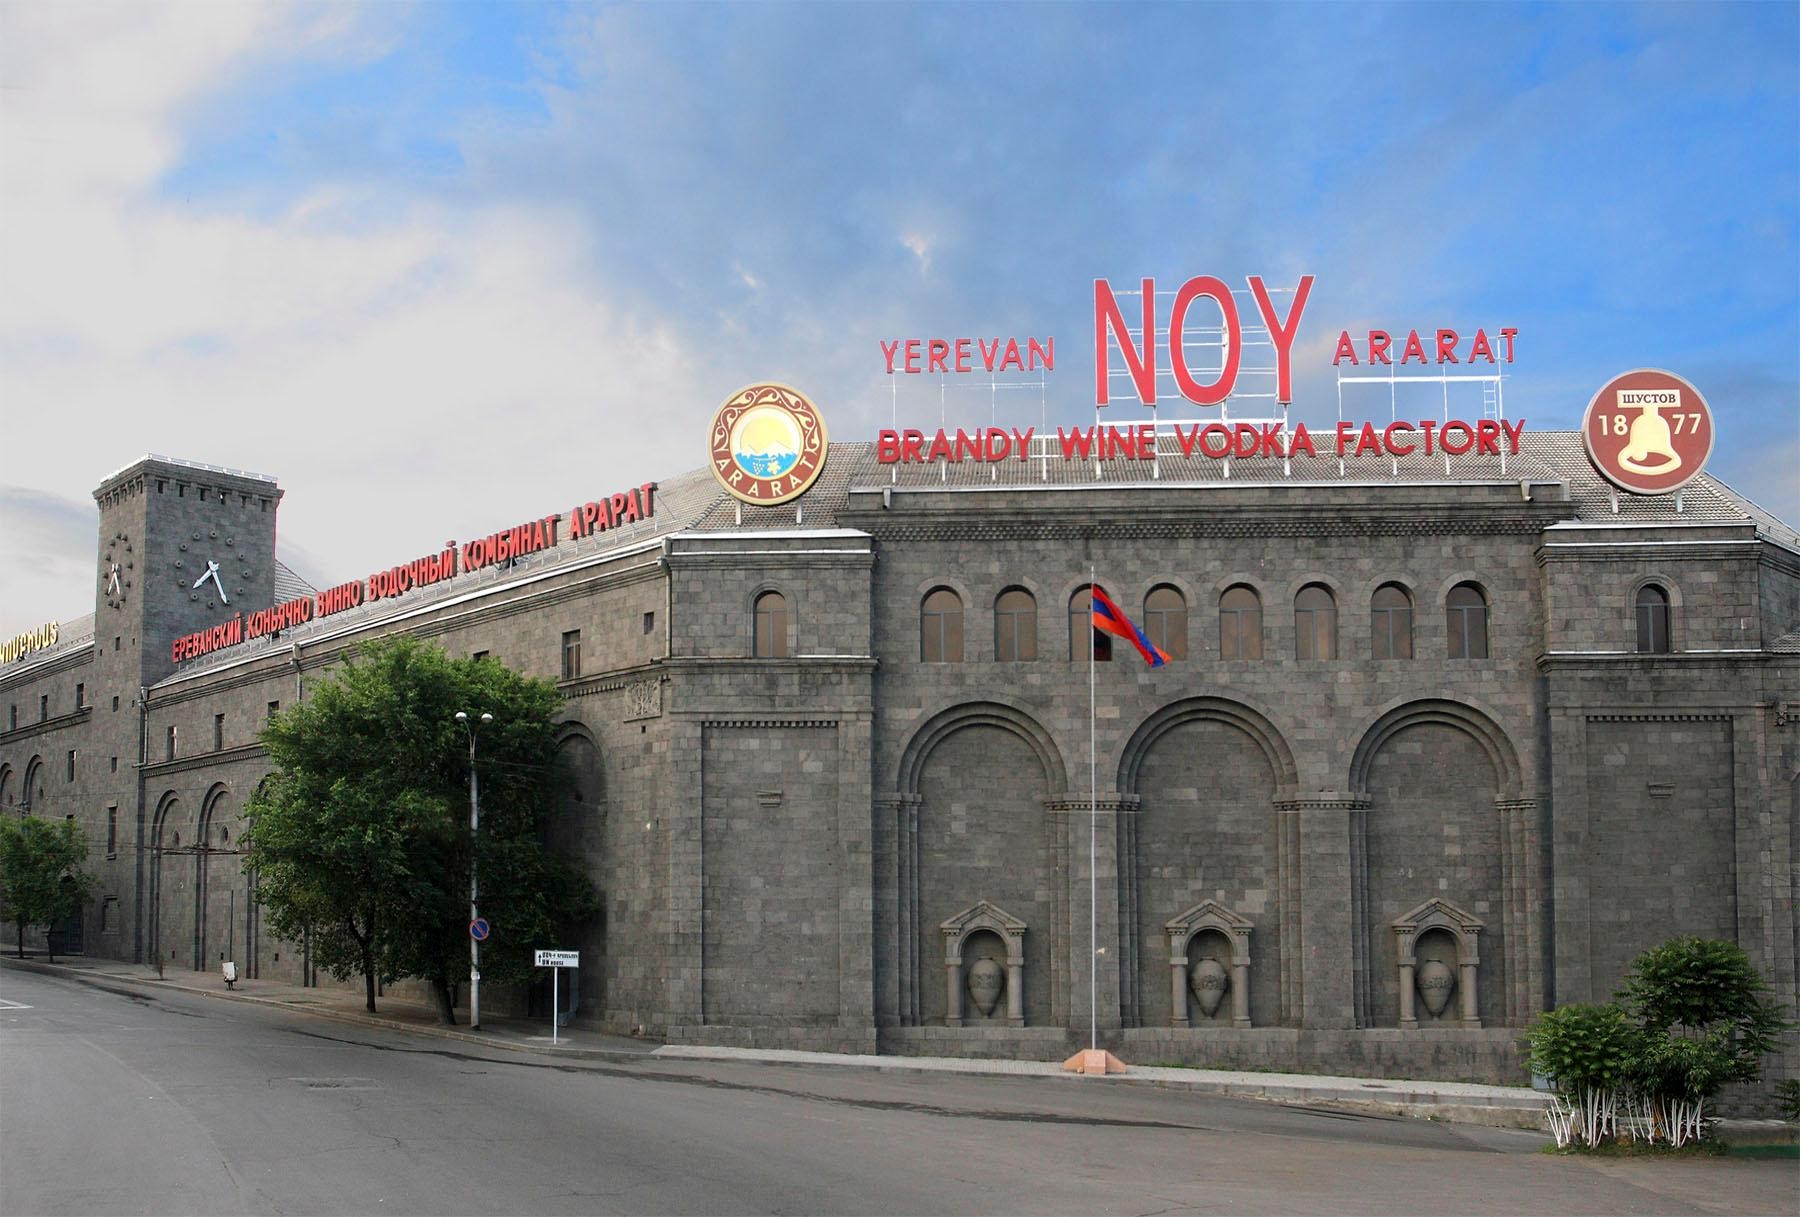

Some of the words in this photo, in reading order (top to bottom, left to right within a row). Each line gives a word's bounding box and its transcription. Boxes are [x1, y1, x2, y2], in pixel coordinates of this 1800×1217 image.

[880, 336, 1055, 374] YEREVAN
[1094, 275, 1315, 407] NOY
[1332, 328, 1518, 366] ARARAT
[1622, 393, 1677, 404] ШУСТОВ
[878, 426, 1035, 465] BRANDY
[1057, 423, 1156, 462] WINE
[1173, 421, 1317, 460] VODKA
[1336, 418, 1526, 458] FACTORY
[1598, 414, 1628, 436] 18
[1672, 413, 1702, 435] 77
[715, 456, 815, 497] ARARAT
[172, 611, 243, 663] ЕРЕВАНСКИЙ
[247, 596, 313, 640] КОНЬЯЧНО
[316, 580, 363, 618] ВИННО
[368, 540, 457, 602] ВОДОЧНЫЙ
[461, 513, 560, 572] КОМБИНАТ
[569, 481, 657, 541] АРАРАТ
